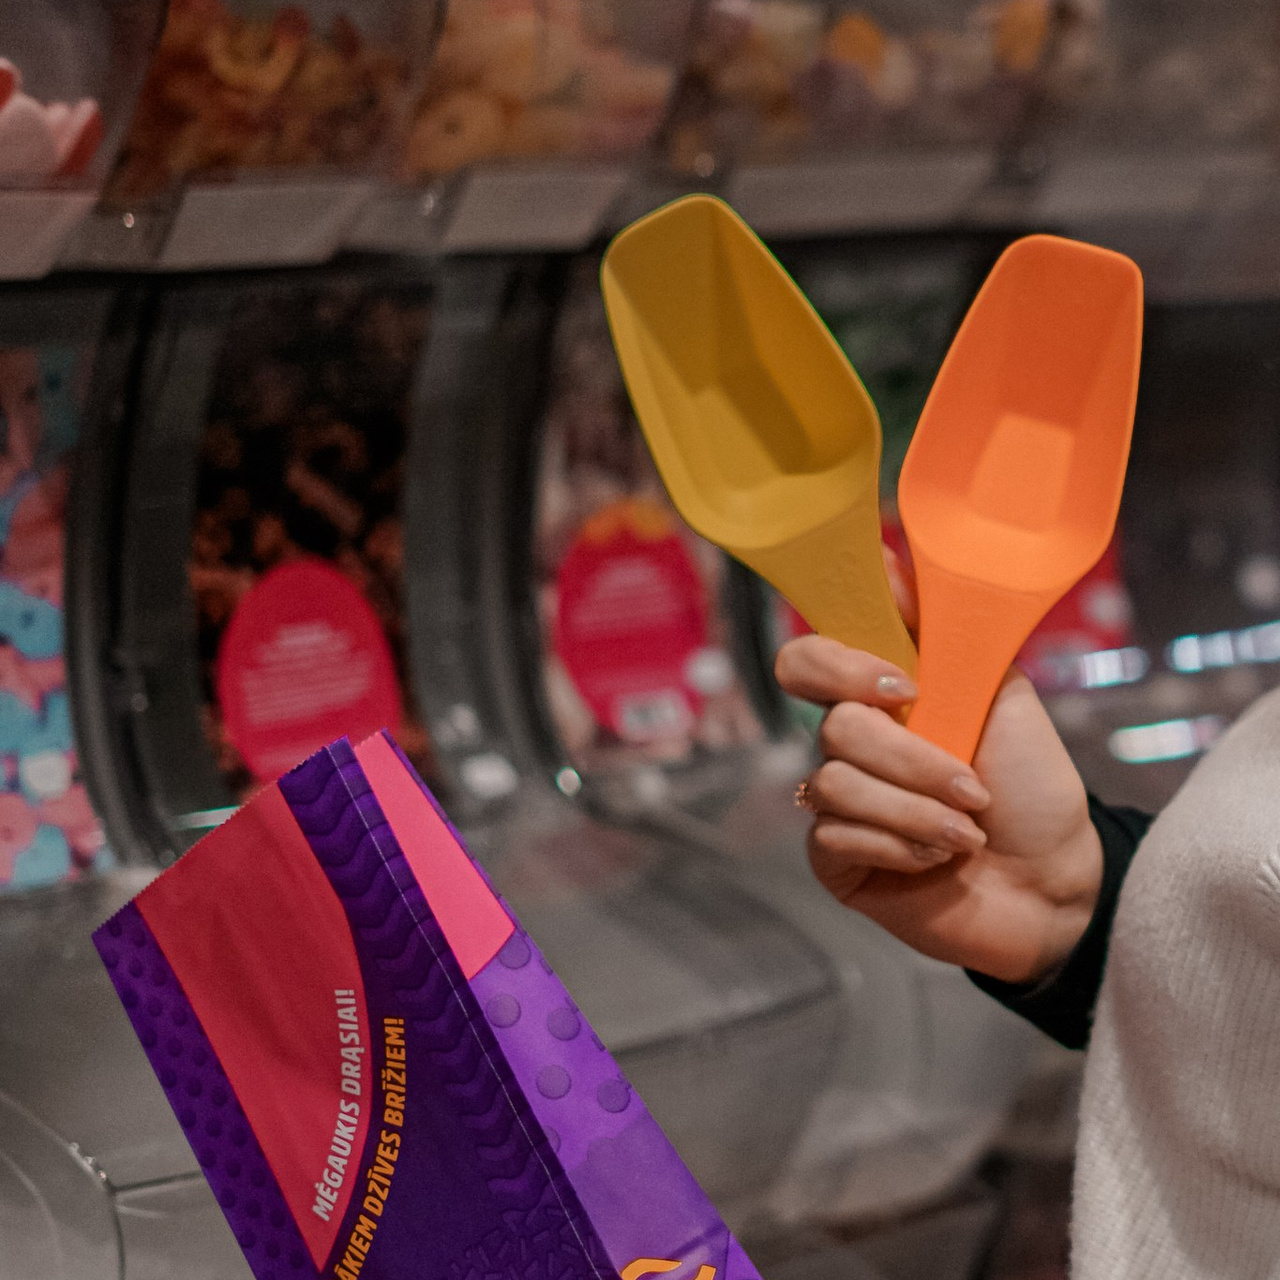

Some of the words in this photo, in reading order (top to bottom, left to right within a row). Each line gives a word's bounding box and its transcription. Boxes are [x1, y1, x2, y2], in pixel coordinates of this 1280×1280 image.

[334, 989, 365, 1096] DRĄSIAI!
[381, 1018, 406, 1127] BRĪŽIEM!
[312, 1099, 360, 1221] MĖGAUKIS
[363, 1130, 401, 1216] DZĪVES
